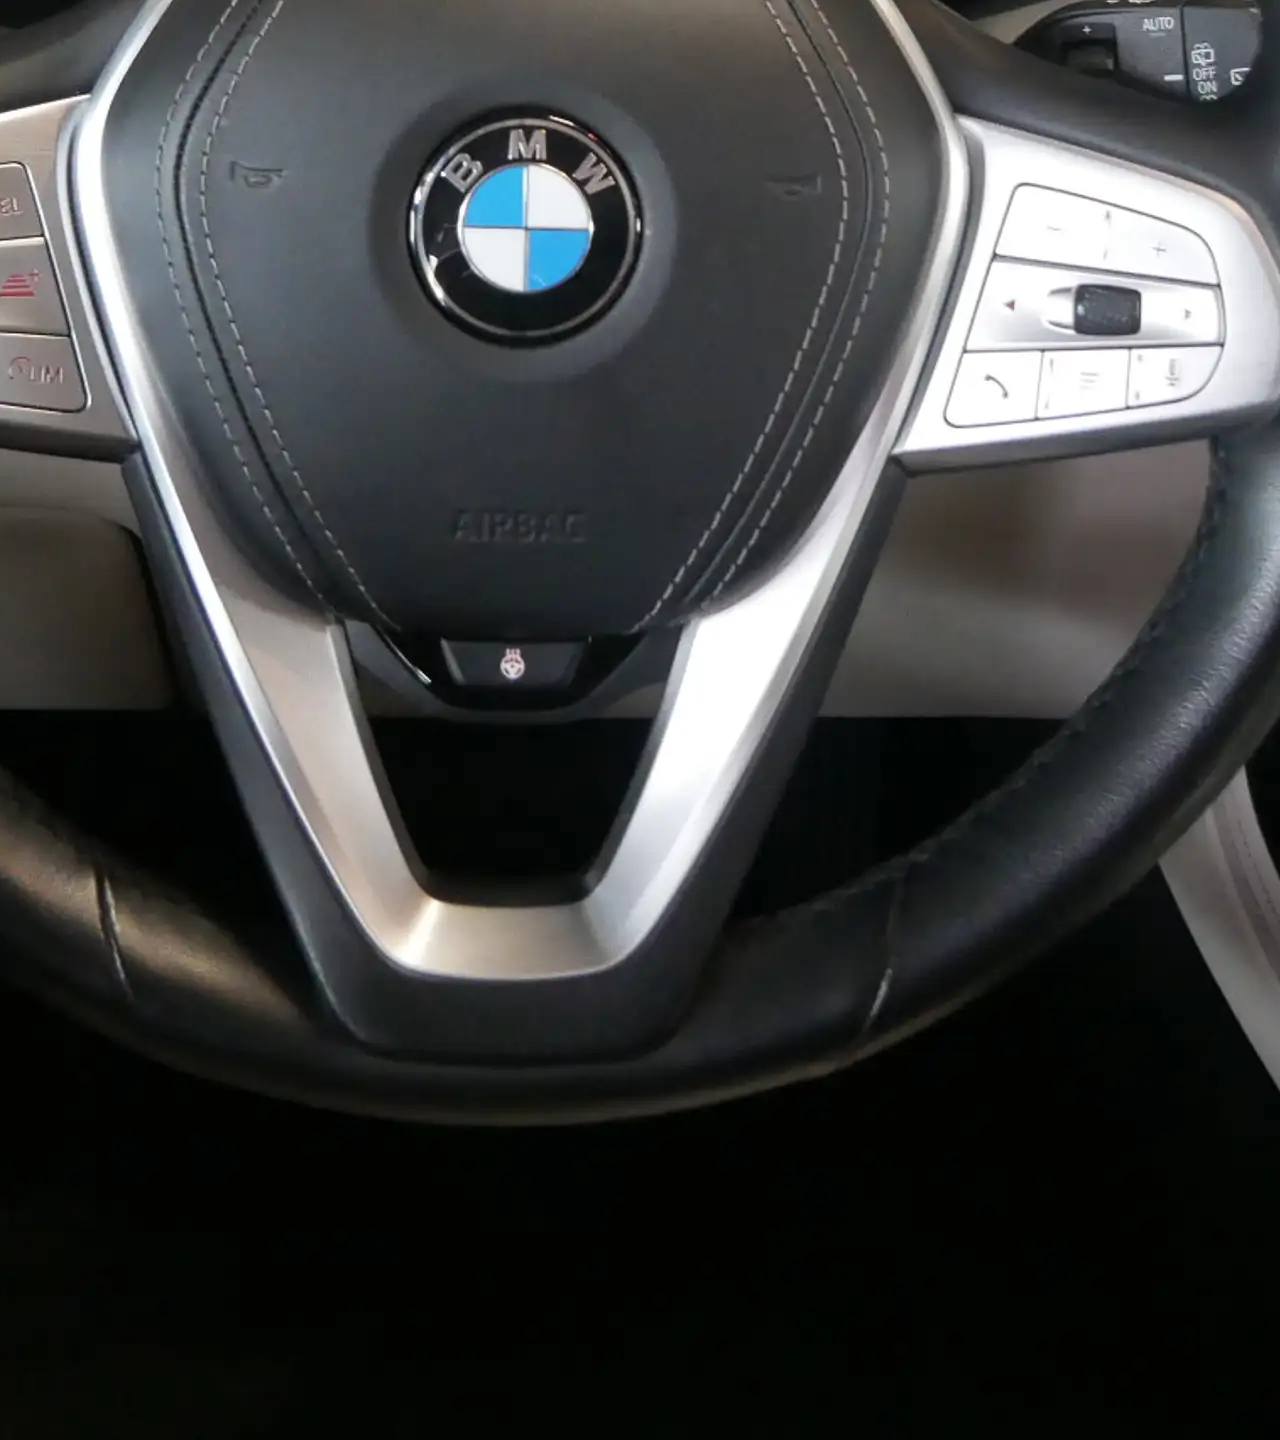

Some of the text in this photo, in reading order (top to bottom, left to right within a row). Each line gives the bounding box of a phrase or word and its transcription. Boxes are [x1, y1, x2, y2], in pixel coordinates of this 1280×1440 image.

[1142, 16, 1175, 31] AUTO
[1192, 67, 1216, 82] OFF
[1197, 81, 1218, 94] ON
[442, 129, 617, 196] BMW
